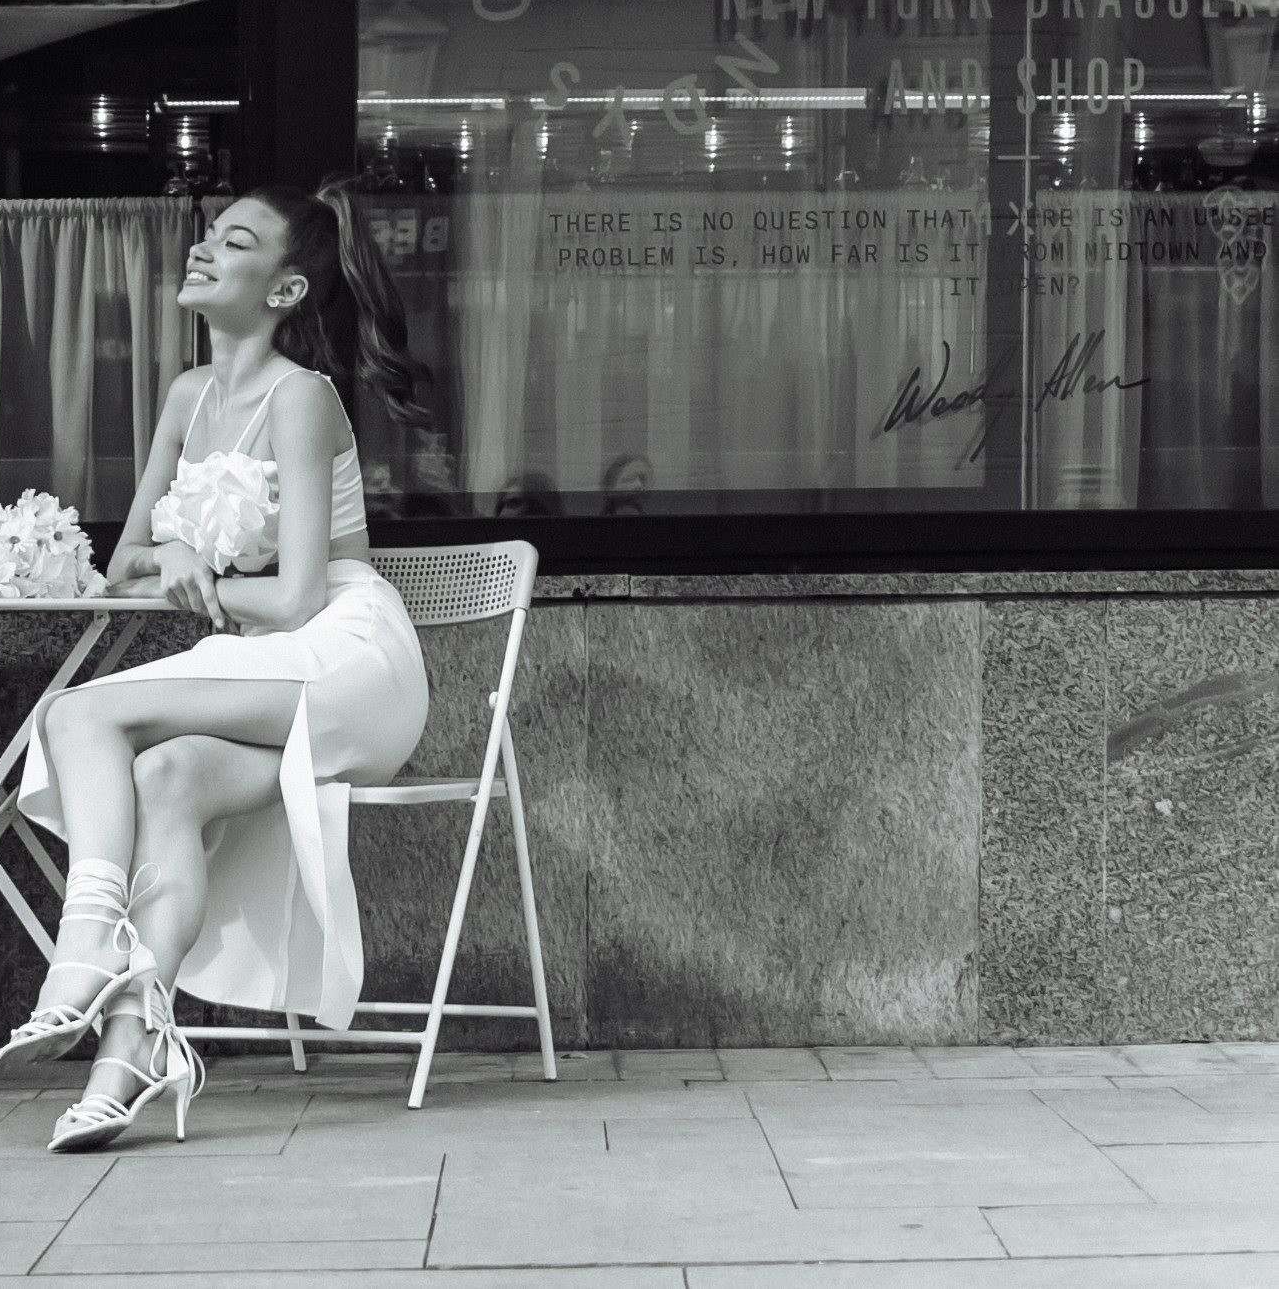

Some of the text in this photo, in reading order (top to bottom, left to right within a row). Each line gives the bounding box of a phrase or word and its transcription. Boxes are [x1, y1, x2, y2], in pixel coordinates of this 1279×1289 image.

[884, 57, 1146, 115] AND SHOP
[549, 212, 632, 235] THERE
[652, 211, 683, 233] IS
[701, 211, 735, 232] NO
[752, 209, 888, 232] QUESTION
[908, 209, 972, 229] THAT
[1095, 208, 1124, 227] IS
[1144, 208, 1173, 227] AN
[558, 241, 1268, 268] PROBLEM IS, HOW FAR IS IT ROM MIDTOWN AND
[950, 276, 1080, 297] IT PEN?
